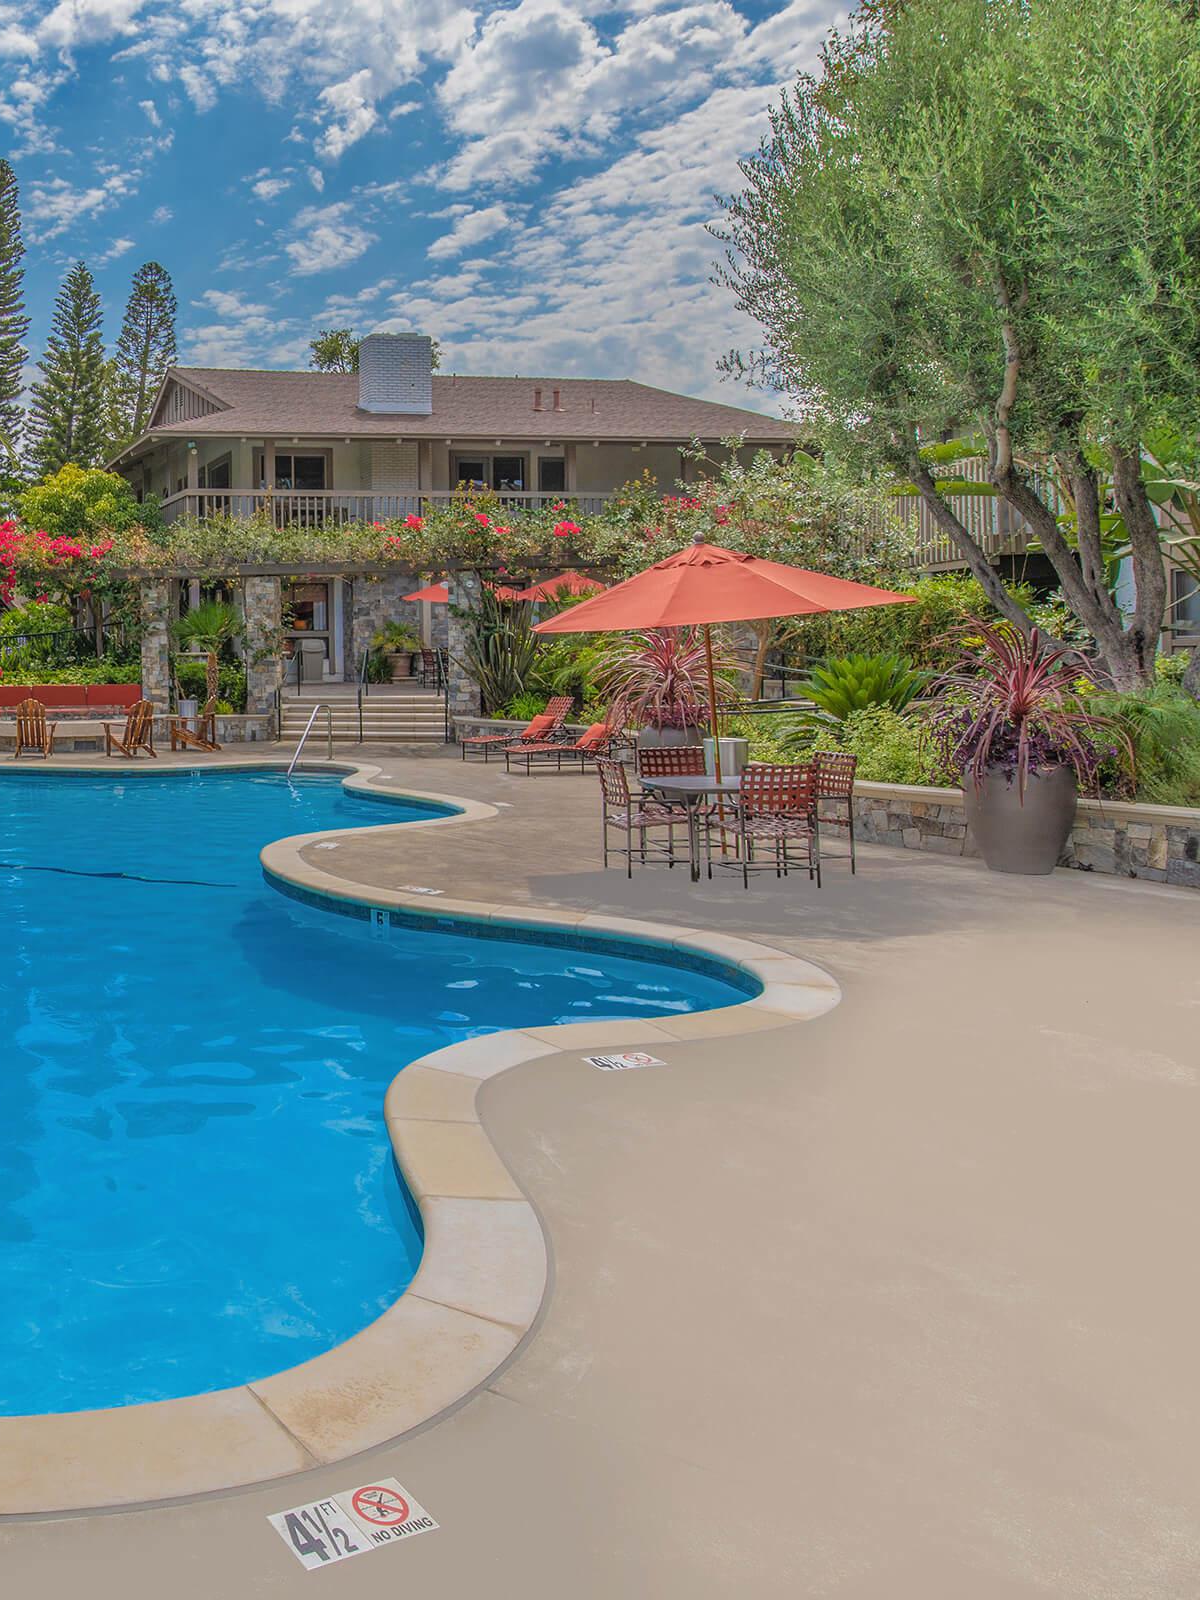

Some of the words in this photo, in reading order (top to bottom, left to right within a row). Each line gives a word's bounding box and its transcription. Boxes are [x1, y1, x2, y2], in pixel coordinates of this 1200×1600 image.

[320, 1501, 337, 1516] FT
[371, 1529, 392, 1543] NO
[393, 1517, 434, 1538] DIVING
